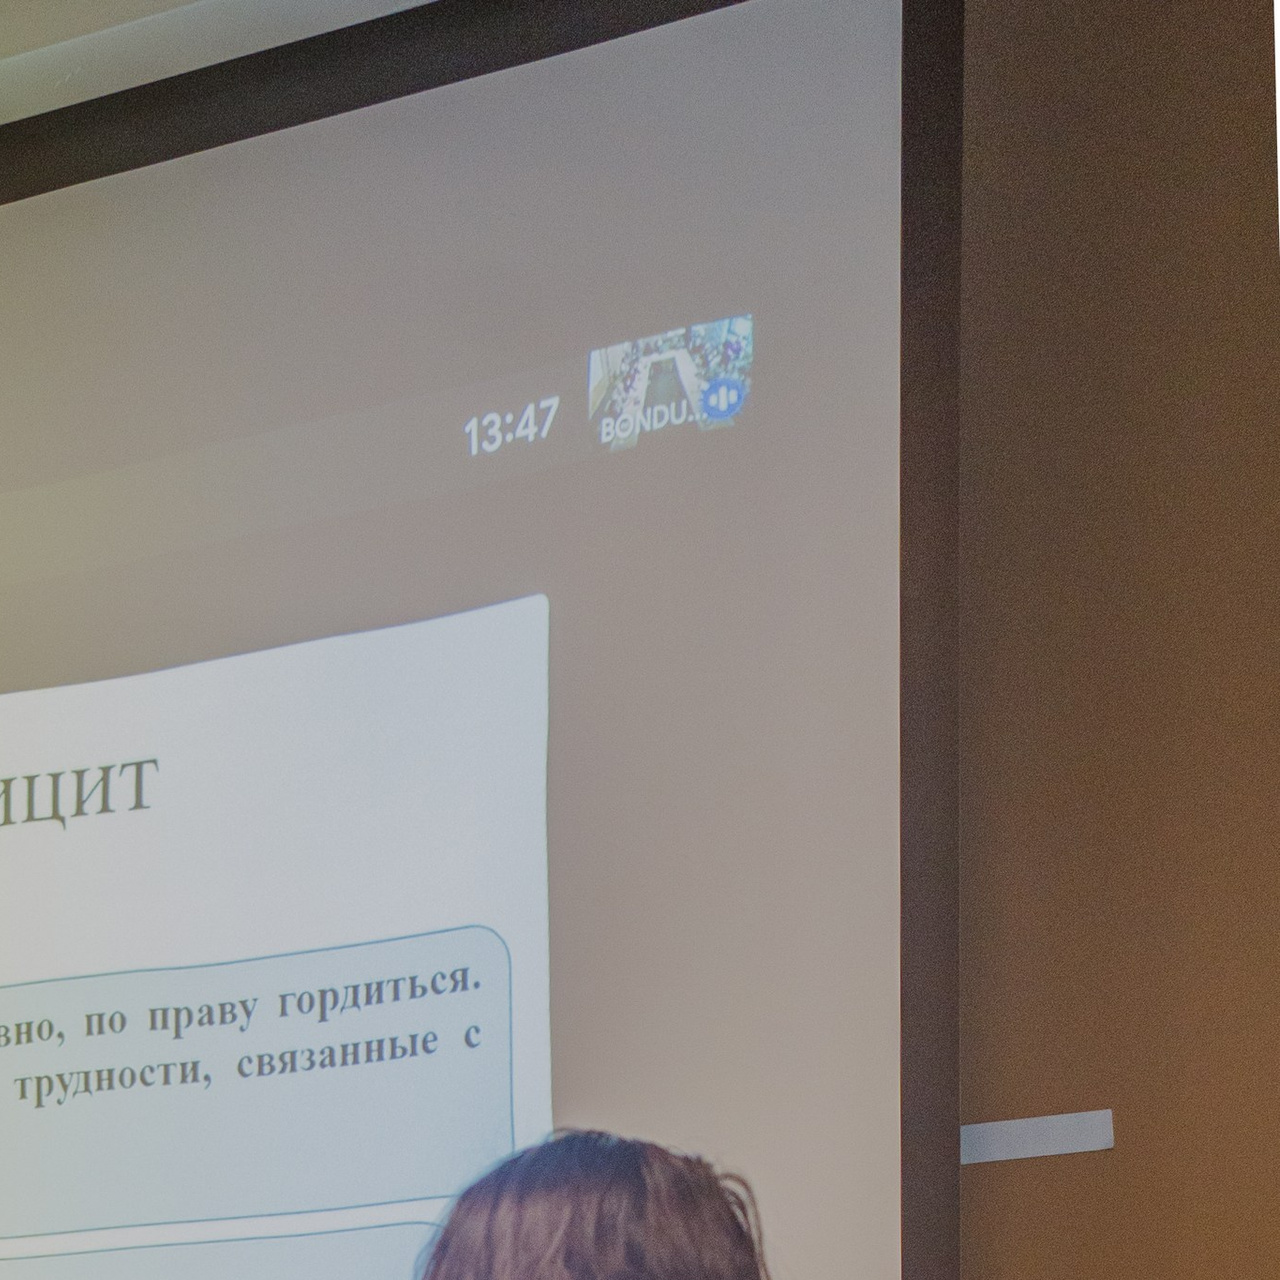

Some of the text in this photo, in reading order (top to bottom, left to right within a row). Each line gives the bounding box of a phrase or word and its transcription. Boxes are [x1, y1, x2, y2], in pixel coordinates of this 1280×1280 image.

[464, 395, 560, 457] 13:47
[84, 1010, 128, 1037] по
[148, 997, 259, 1040] праву
[278, 966, 482, 1024] гордиться.
[13, 1059, 213, 1110] трудности,
[236, 1030, 439, 1079] связанные
[463, 1024, 482, 1050] с
